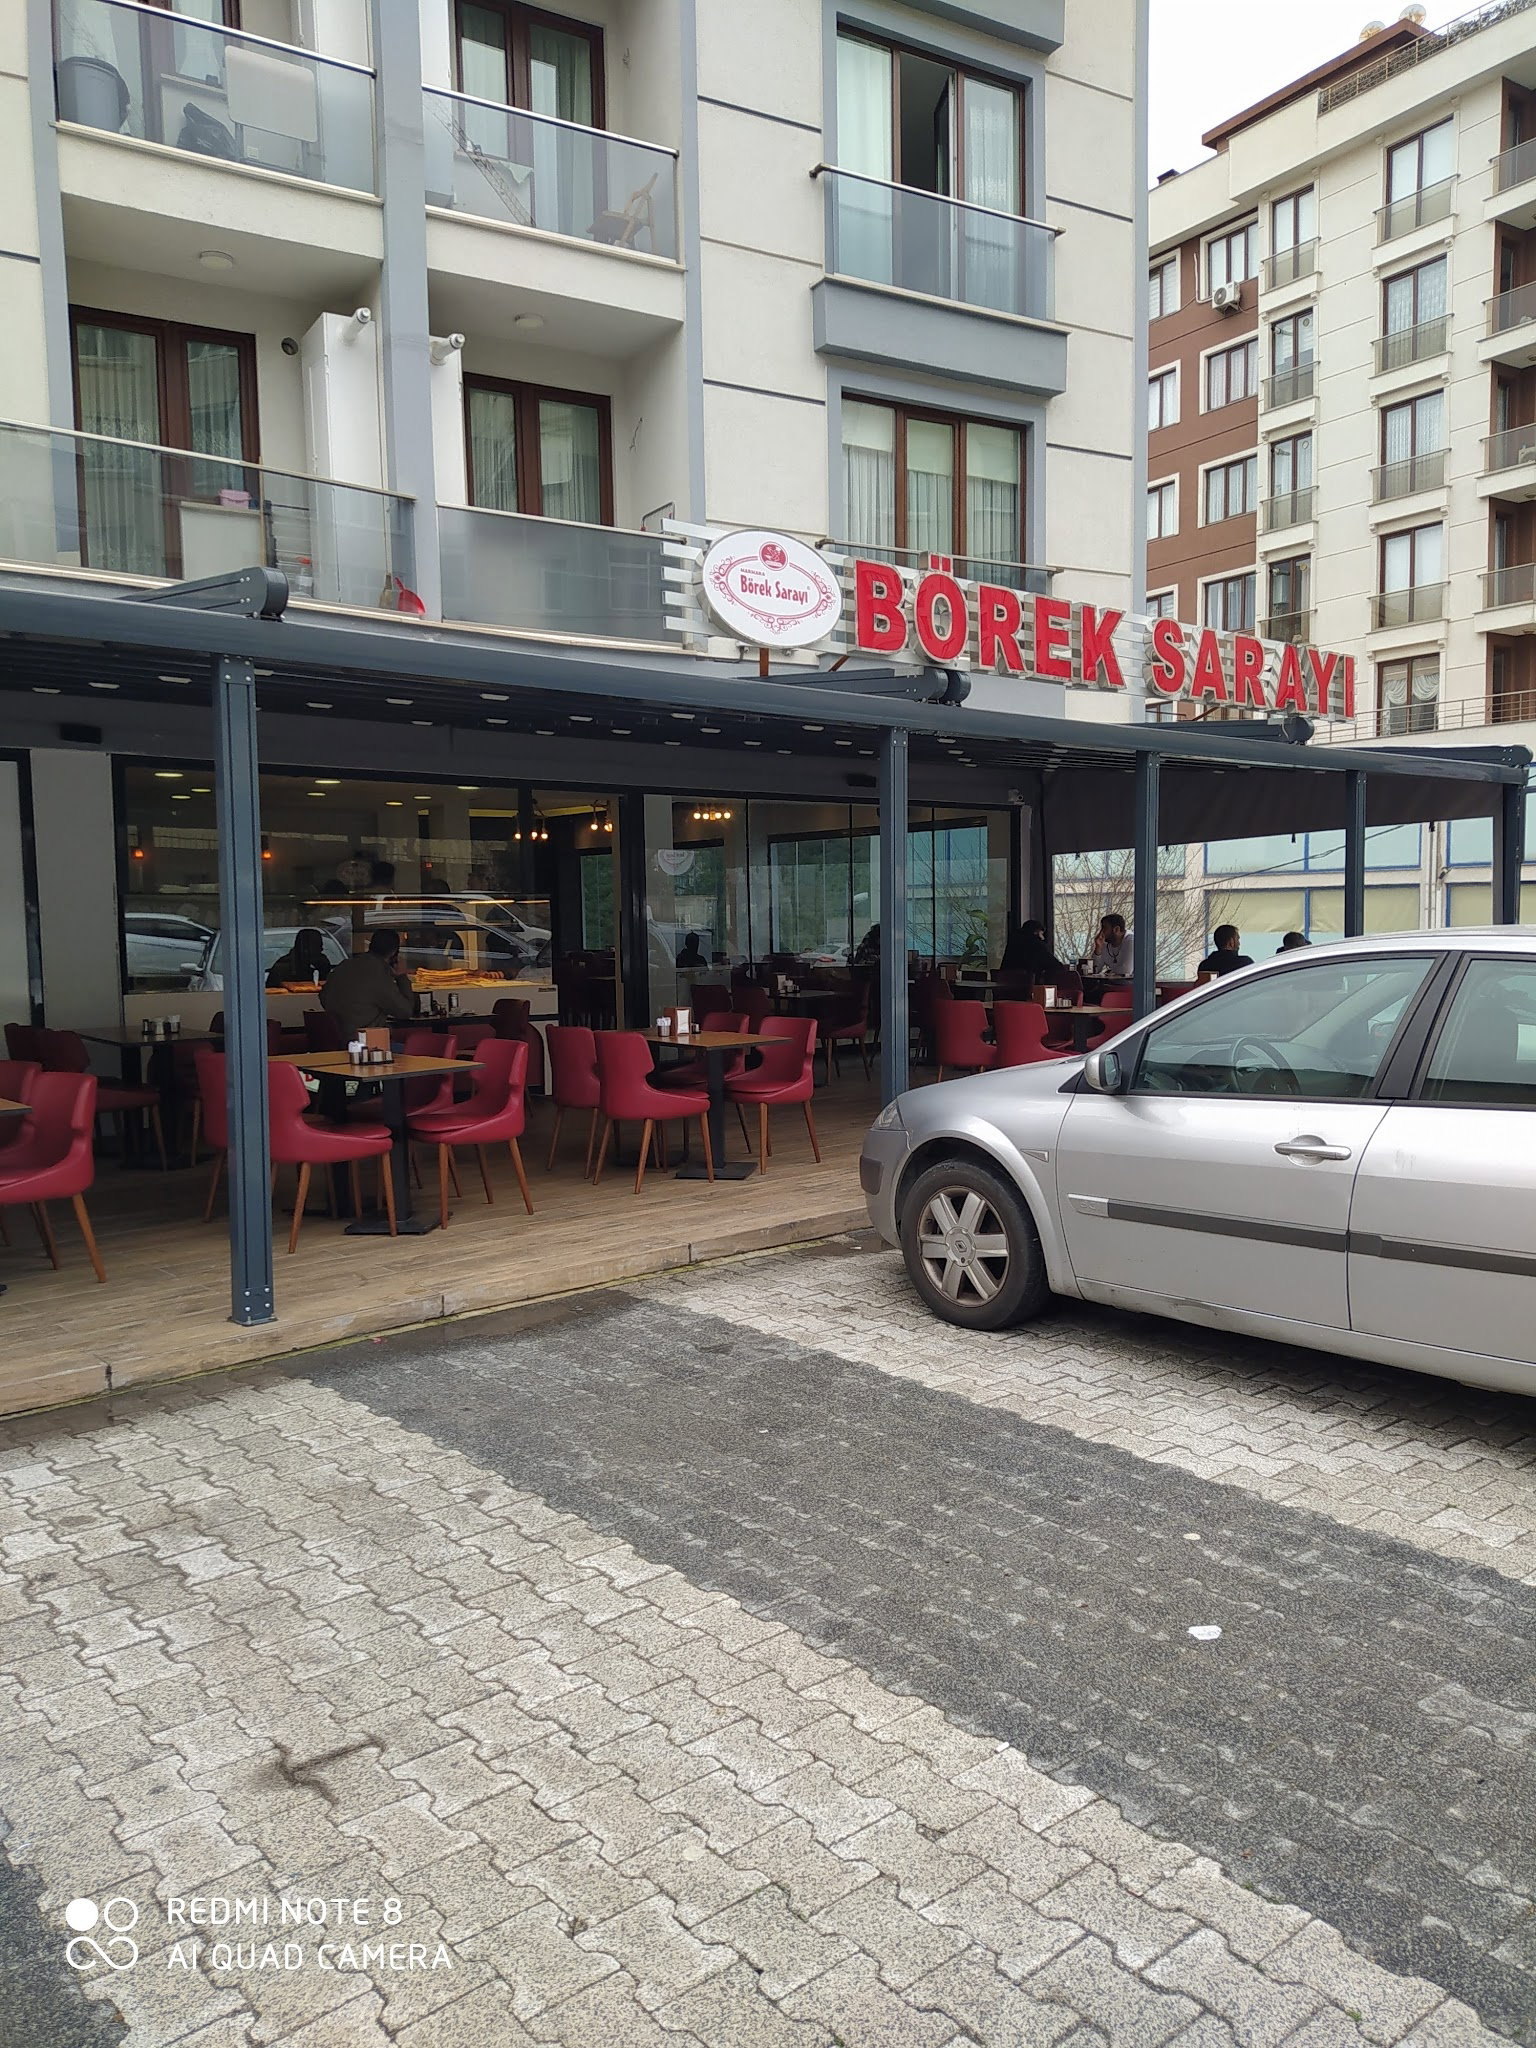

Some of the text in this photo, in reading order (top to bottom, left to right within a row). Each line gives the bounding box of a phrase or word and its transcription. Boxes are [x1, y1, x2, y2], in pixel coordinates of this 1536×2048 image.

[740, 574, 808, 605] Börek Sarayı
[854, 553, 1355, 719] BÖREK SARAYI
